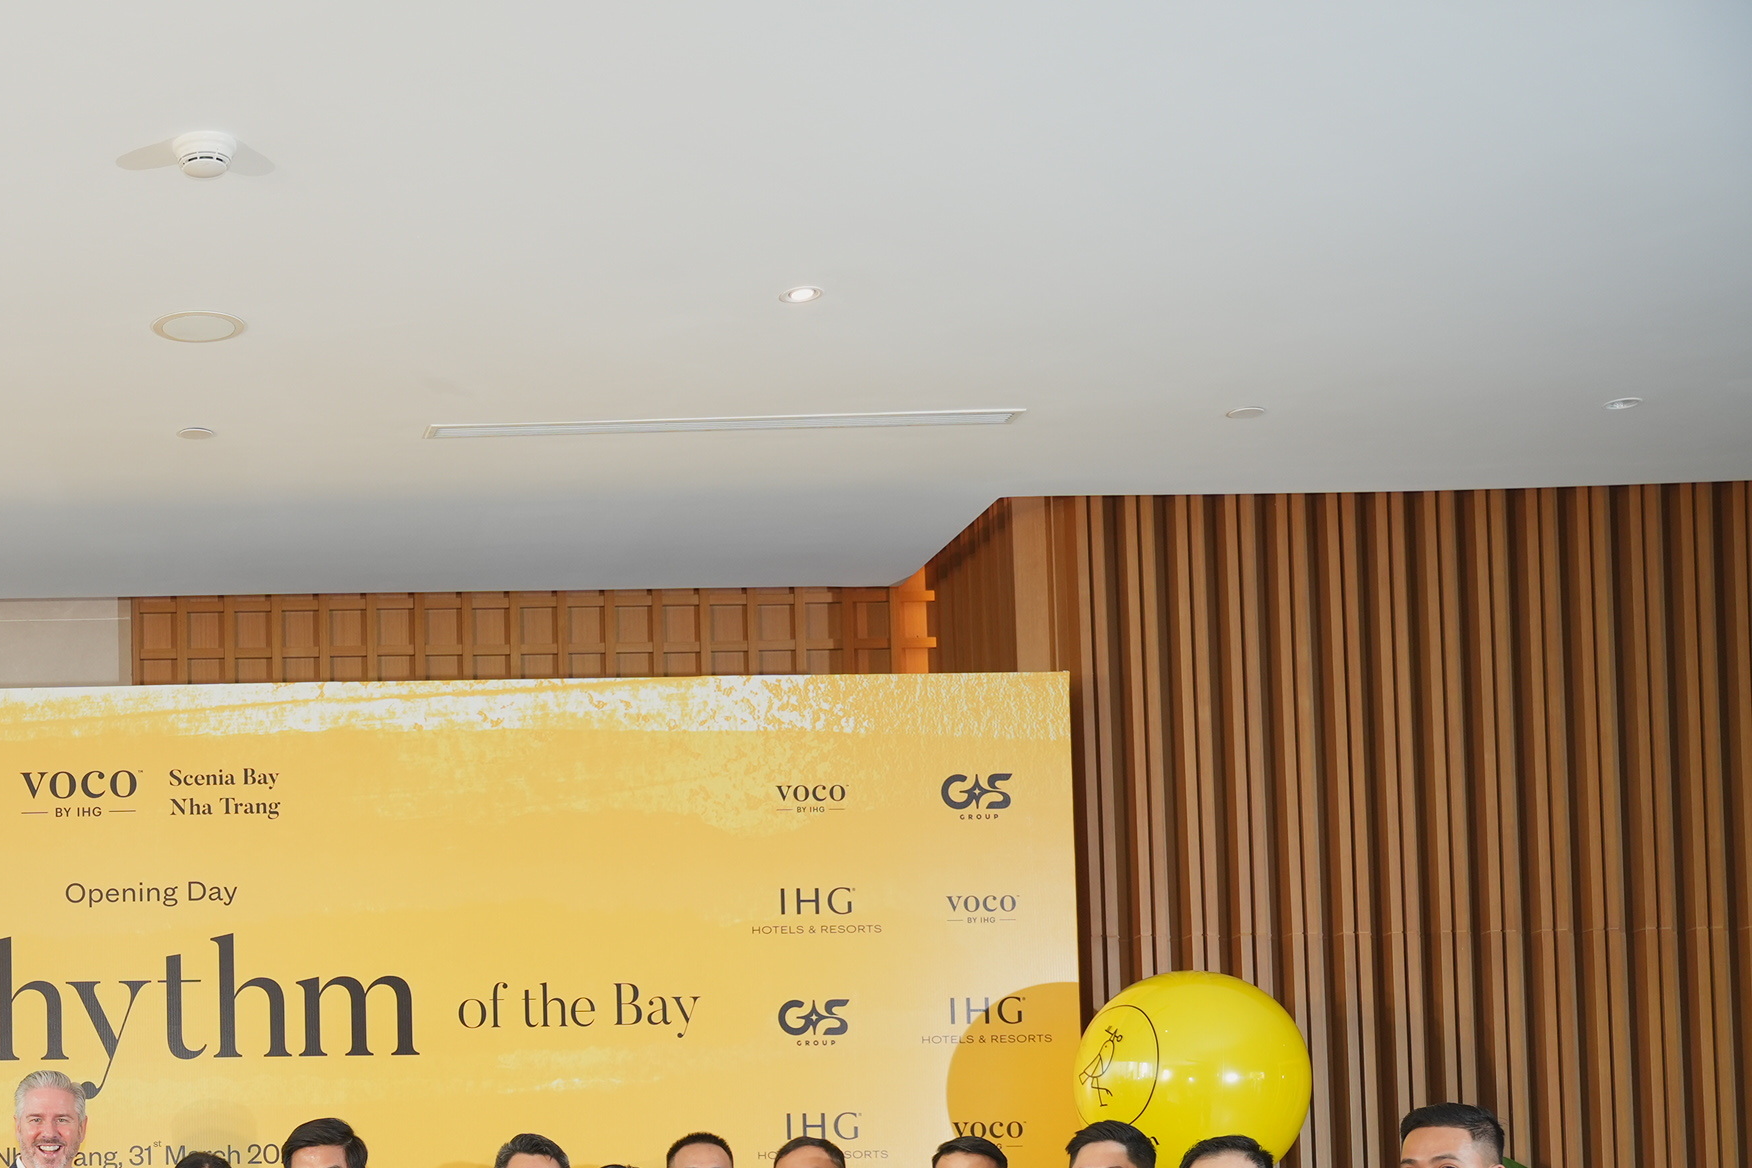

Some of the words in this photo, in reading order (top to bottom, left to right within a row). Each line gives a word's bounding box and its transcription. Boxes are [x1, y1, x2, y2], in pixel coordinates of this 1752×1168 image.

[169, 768, 236, 787] Scenia
[243, 767, 280, 789] Bay
[55, 807, 71, 818] BY
[77, 806, 102, 817] IHG
[170, 797, 213, 816] Nha
[219, 796, 281, 820] Trang
[809, 805, 825, 813] IHG
[65, 882, 179, 908] Opening
[187, 880, 239, 907] Day
[780, 886, 853, 915] IHG
[751, 925, 805, 935] HOTELS
[808, 924, 817, 934] &
[820, 924, 883, 934] RESORTS
[980, 916, 996, 924] IHG
[458, 981, 508, 1029] of
[521, 981, 595, 1028] the
[613, 982, 701, 1038] Bay
[949, 996, 1025, 1025] IHG
[921, 1034, 975, 1044] HOTELS
[978, 1034, 987, 1043] &
[990, 1033, 1053, 1044] RESORTS
[786, 1111, 860, 1141] IHG
